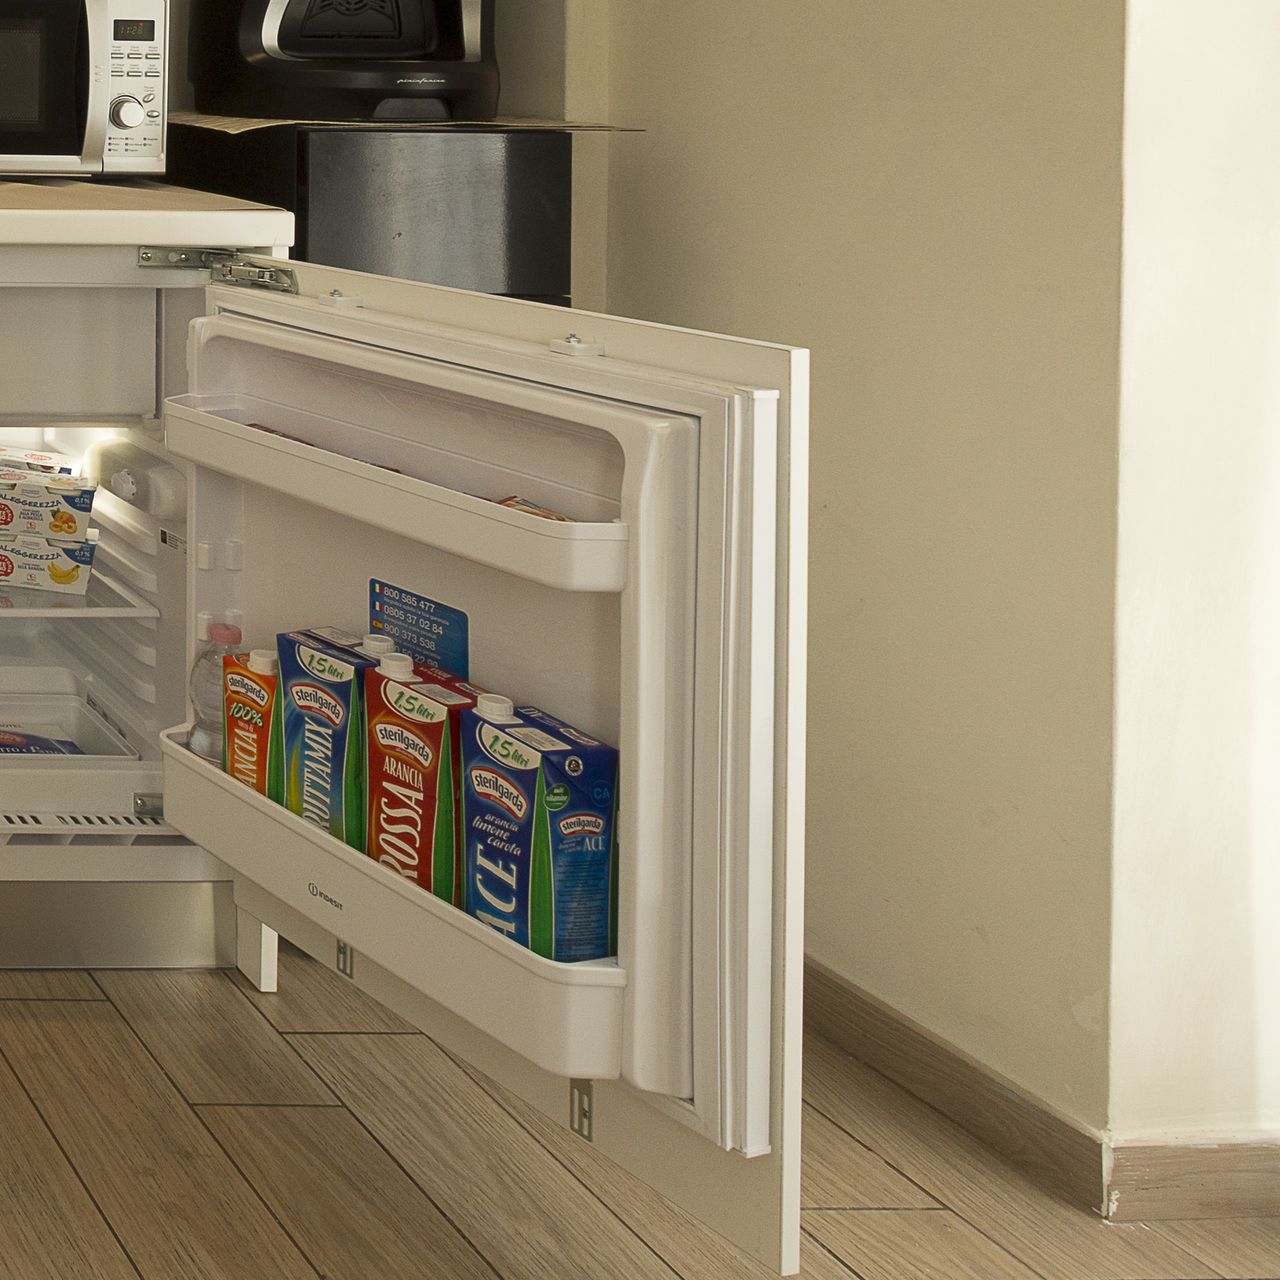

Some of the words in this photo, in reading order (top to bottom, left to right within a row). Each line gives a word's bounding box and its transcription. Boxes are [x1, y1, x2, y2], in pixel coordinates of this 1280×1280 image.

[383, 587, 400, 599] 800
[401, 594, 417, 606] 585
[419, 601, 435, 612] 477
[383, 605, 405, 620] 0805
[406, 614, 417, 624] 37
[419, 619, 431, 630] 02
[432, 624, 443, 635] 84
[384, 624, 400, 636] 900
[401, 630, 418, 644] 373
[419, 639, 436, 651] 538
[327, 664, 345, 680] litri
[229, 675, 266, 701] sterilgarda
[229, 701, 264, 728] 100%
[295, 688, 341, 719] sterilgarda
[416, 703, 436, 721] litri
[234, 727, 257, 787] ANCIA
[379, 726, 430, 762] sterilgarda
[511, 747, 530, 768] litri
[303, 716, 333, 830] RUTTAMIX
[383, 755, 424, 791] ARANCIA
[474, 774, 523, 813] sterilgarda
[472, 815, 510, 840] limone
[484, 813, 520, 832] arancia
[561, 818, 602, 831] sterilgarda
[487, 836, 522, 857] carota
[583, 836, 606, 851] ACE
[476, 843, 517, 936] ACE
